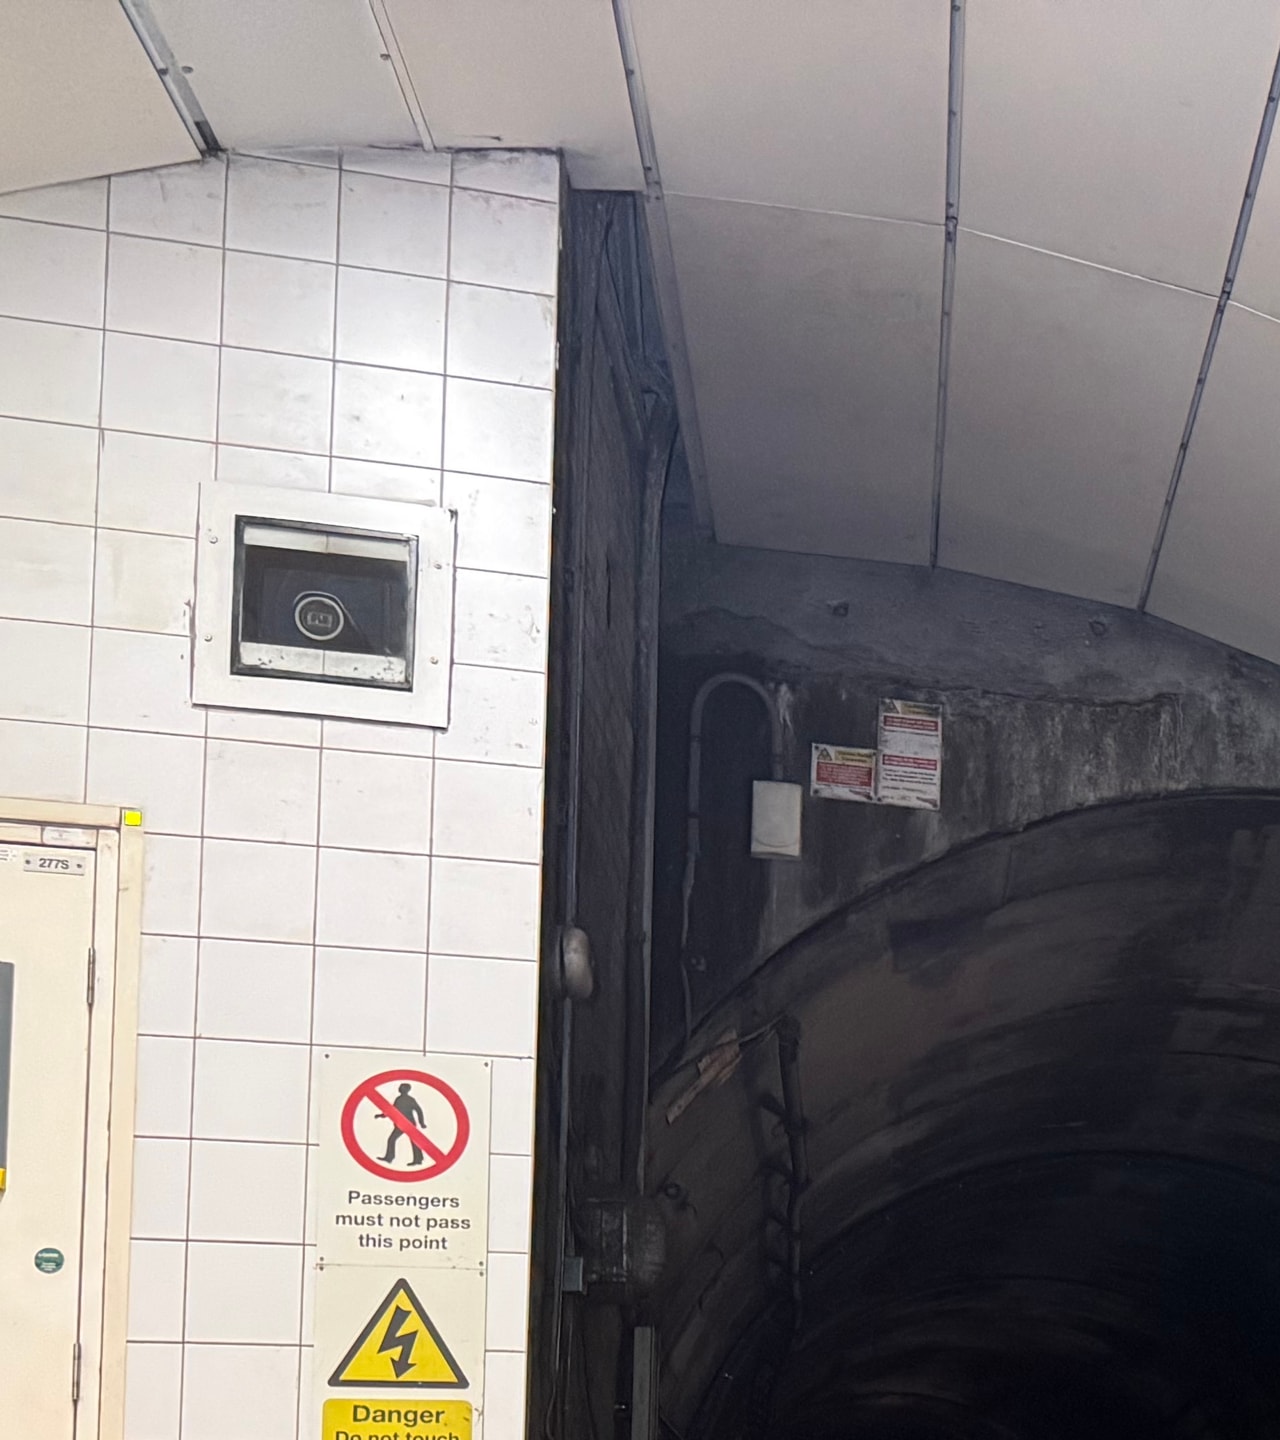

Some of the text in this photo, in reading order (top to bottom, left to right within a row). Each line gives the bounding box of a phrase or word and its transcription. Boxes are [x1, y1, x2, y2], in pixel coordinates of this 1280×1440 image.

[347, 1190, 460, 1210] Passengers
[335, 1213, 471, 1231] must not pass
[358, 1233, 448, 1251] this point
[352, 1404, 446, 1428] Danger
